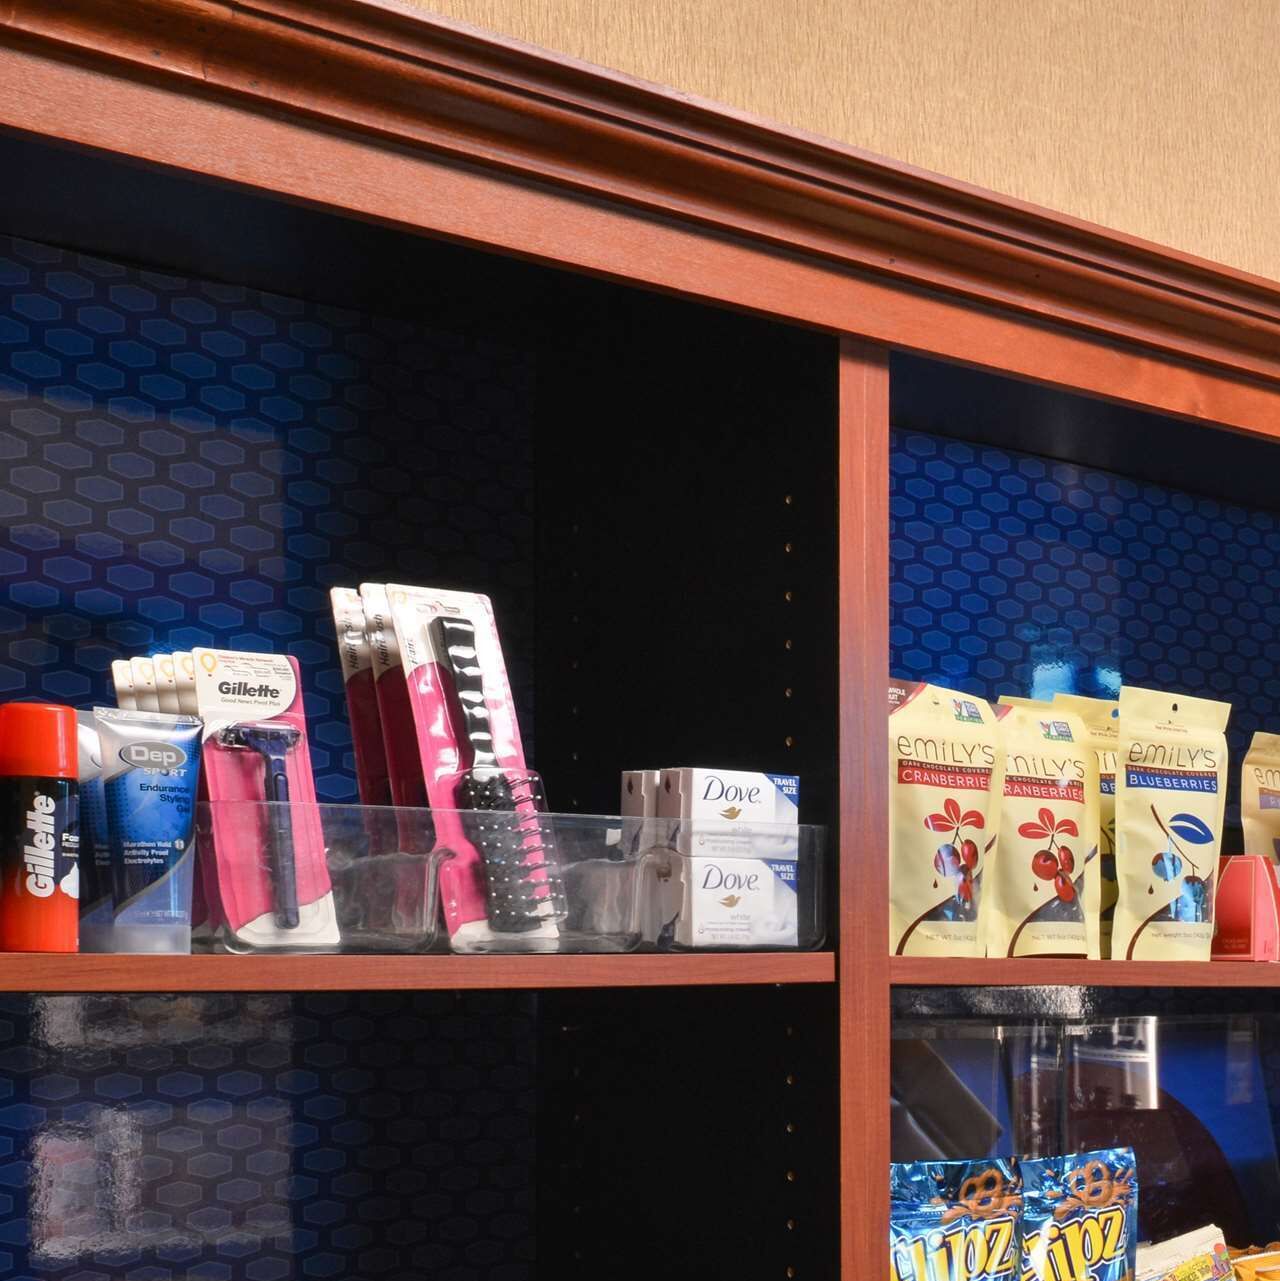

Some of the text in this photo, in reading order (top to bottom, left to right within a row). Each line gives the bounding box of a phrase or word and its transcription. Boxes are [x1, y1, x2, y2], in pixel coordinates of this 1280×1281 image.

[218, 681, 280, 698] Gillette
[131, 745, 177, 766] Dep
[143, 768, 188, 777] SPORT
[922, 763, 960, 772] CHOCOLATE
[774, 778, 797, 786] TRAVEL
[1129, 774, 1217, 791] BLUEBERRIES
[140, 784, 190, 793] Endurance
[703, 776, 761, 804] Dove
[783, 787, 797, 795] SIZE
[159, 793, 190, 806] Styling
[24, 794, 56, 898] Gillette
[772, 864, 795, 872] TRAVEL
[702, 864, 760, 890] Dove
[781, 872, 795, 880] SIZE
